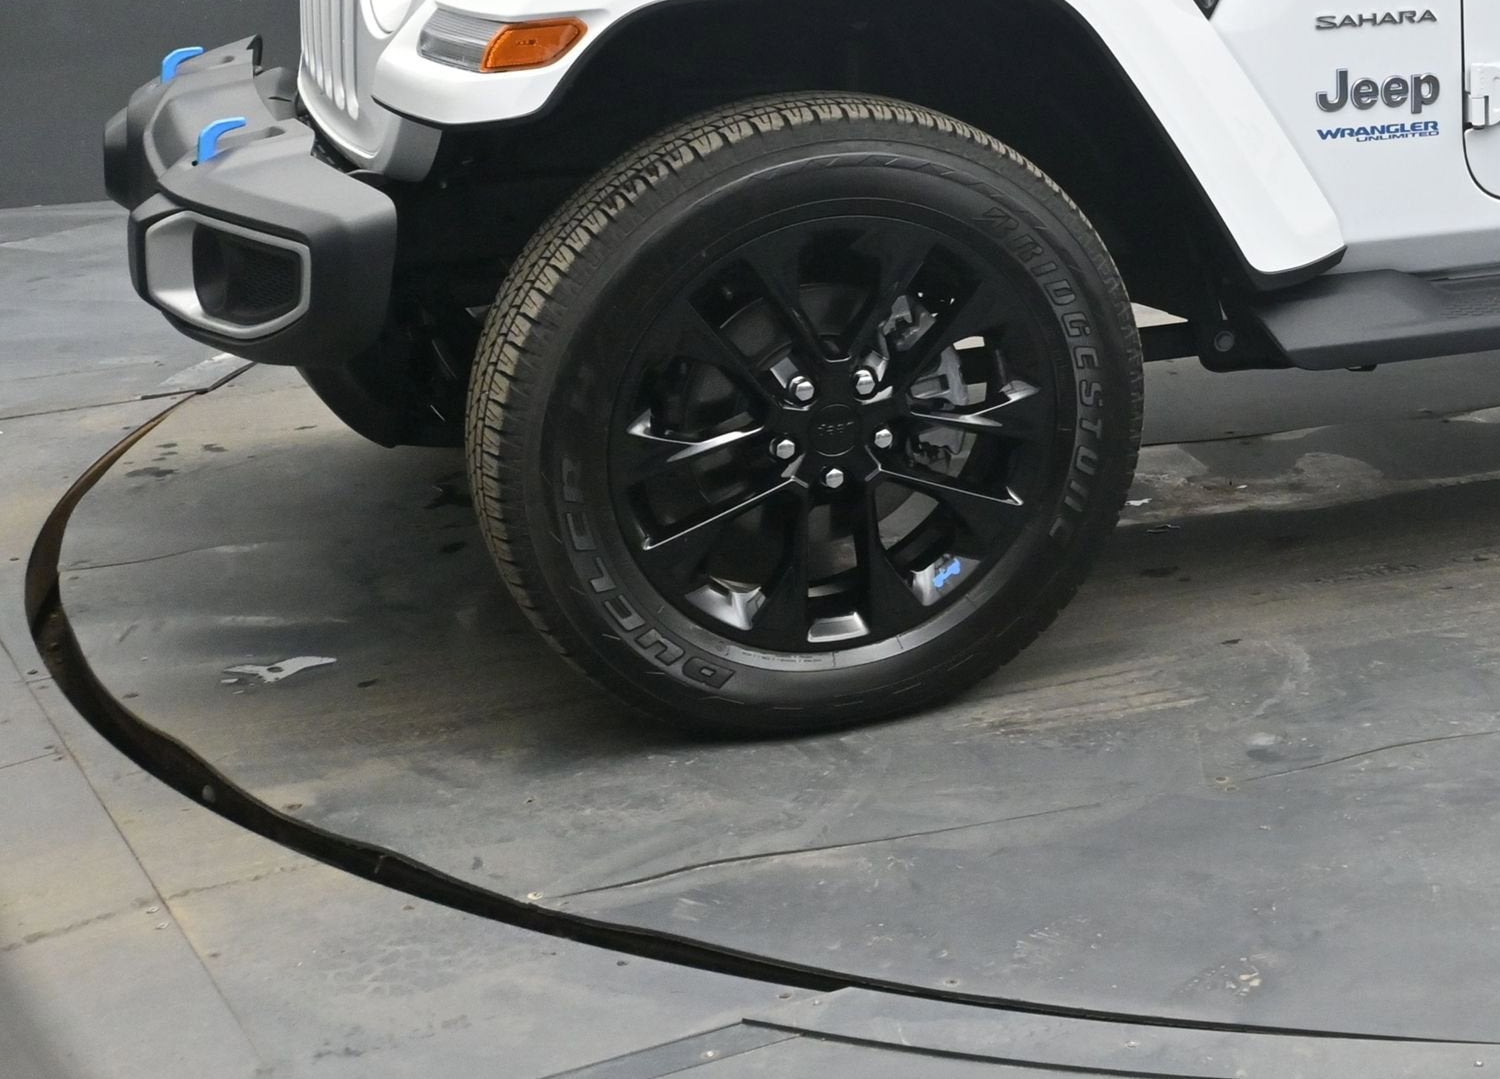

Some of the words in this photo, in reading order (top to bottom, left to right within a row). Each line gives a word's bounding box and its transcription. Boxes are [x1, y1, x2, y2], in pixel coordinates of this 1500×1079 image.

[1315, 9, 1438, 30] SAHARA
[1316, 68, 1440, 114] Jeep
[1317, 121, 1438, 139] WRANGLER
[1356, 130, 1439, 142] UNLIMITED
[562, 455, 736, 690] DUELER
